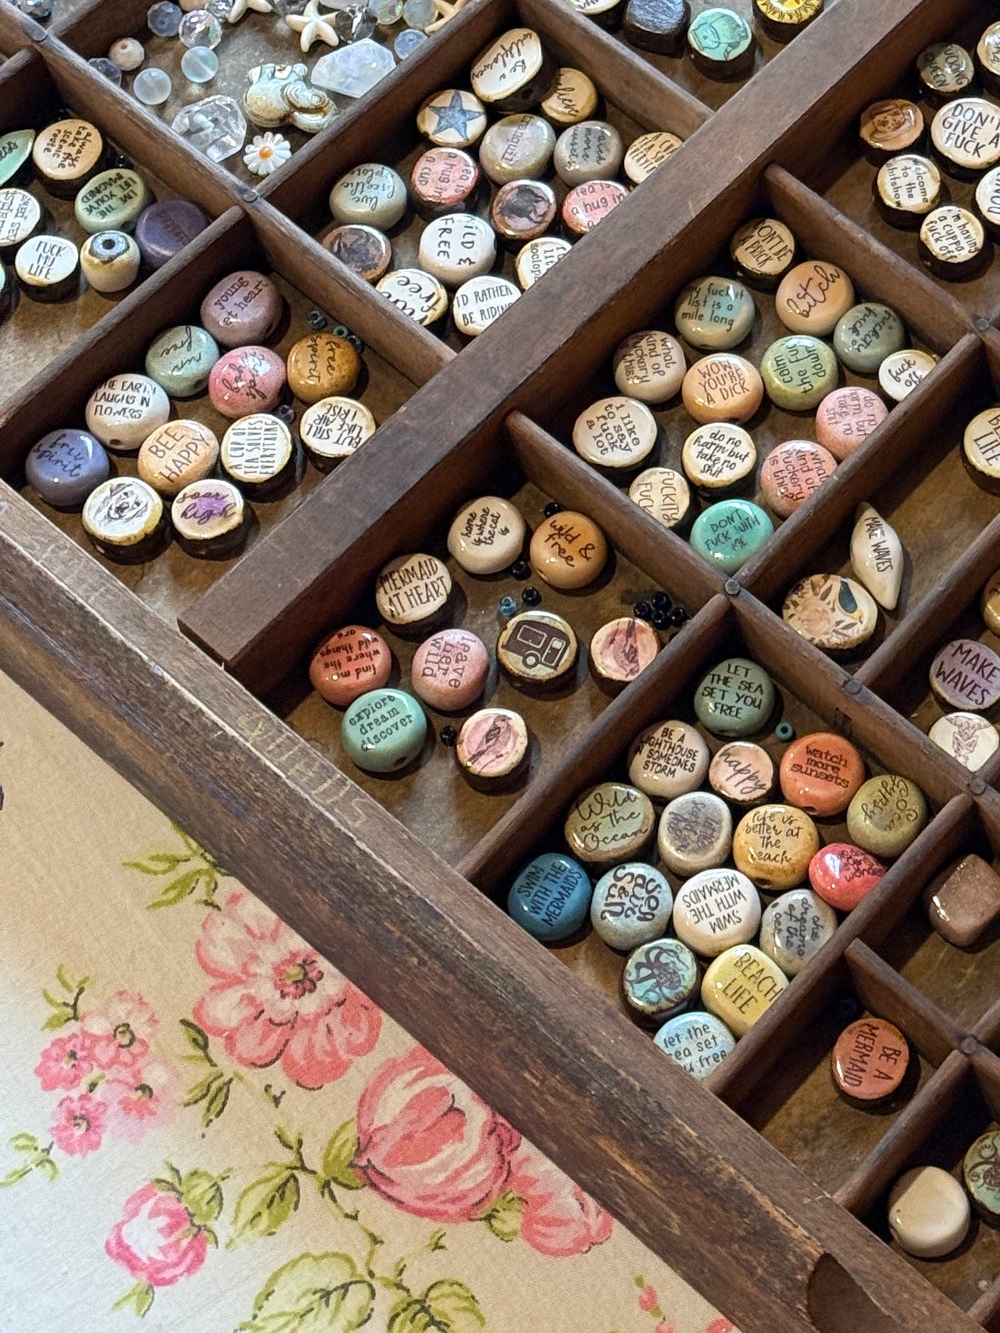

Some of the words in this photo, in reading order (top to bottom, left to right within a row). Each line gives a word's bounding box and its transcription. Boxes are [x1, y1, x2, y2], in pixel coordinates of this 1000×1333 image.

[942, 113, 979, 138] GIVE
[988, 133, 1000, 148] A
[946, 131, 986, 158] FUCK
[902, 167, 912, 180] to
[912, 158, 929, 204] welcome
[906, 182, 914, 198] the
[571, 206, 579, 215] a
[582, 195, 608, 213] hug
[437, 218, 454, 259] FREE
[926, 218, 943, 244] fuck
[940, 245, 958, 261] off
[958, 218, 980, 255] having
[36, 241, 66, 257] FUCK
[37, 253, 56, 265] MY
[27, 263, 53, 279] LIFE
[214, 276, 250, 310] young
[236, 280, 268, 312] heart
[474, 285, 512, 303] RATHER
[462, 314, 474, 326] BE
[698, 360, 733, 379] WOW
[888, 359, 916, 383] fuck
[698, 370, 745, 394] YOU'RE
[705, 393, 716, 406] A
[721, 381, 750, 399] DICK
[93, 392, 135, 404] LAUGHS
[140, 396, 151, 407] IN
[93, 405, 143, 419] FLOWERS
[246, 420, 264, 456] SOLVES
[587, 420, 594, 429] a
[594, 432, 609, 455] lot
[596, 415, 619, 451] fuck
[604, 404, 616, 420] to
[612, 420, 632, 453] say
[621, 413, 641, 445] like
[709, 430, 724, 441] do
[726, 435, 742, 446] no
[148, 425, 185, 459] BEE
[231, 440, 246, 458] CUP
[260, 420, 277, 475] EVERYTHING
[693, 435, 727, 458] harm
[729, 448, 750, 463] but
[159, 435, 210, 484] HAPPY
[244, 458, 259, 475] TEA
[695, 449, 718, 465] take
[719, 458, 737, 470] no
[700, 463, 724, 477] shit
[704, 532, 731, 551] FUCK
[736, 515, 760, 535] WITH
[711, 510, 743, 532] DON'T
[730, 536, 748, 551] ME
[380, 558, 440, 596] MERMAID
[388, 599, 405, 616] AT
[406, 578, 450, 612] HEART
[421, 636, 445, 678] wild
[436, 639, 452, 675] her
[449, 635, 478, 688] leave
[727, 663, 752, 676] LET
[709, 673, 731, 686] THE
[737, 680, 764, 695] SEA
[935, 661, 990, 706] WAVES
[702, 686, 729, 699] SET
[735, 692, 762, 709] YOU
[713, 701, 743, 719] FREE
[661, 728, 675, 741] BE
[678, 734, 686, 744] A
[647, 748, 696, 773] SOMEONES
[805, 745, 848, 766] watch
[805, 757, 840, 774] more
[643, 759, 676, 778] STORM
[791, 763, 850, 789] sunsets
[682, 875, 740, 908] MERMAIDS
[717, 891, 747, 913] WITH
[690, 906, 714, 923] THE
[711, 910, 742, 933] SWIM
[734, 952, 782, 1002] BEACH
[723, 978, 757, 1014] LIFE
[664, 1035, 682, 1048] let
[687, 1023, 710, 1041] the
[697, 1036, 718, 1053] set
[845, 1022, 879, 1087] MERMAID
[881, 1046, 902, 1066] BE
[872, 1068, 894, 1081] A
